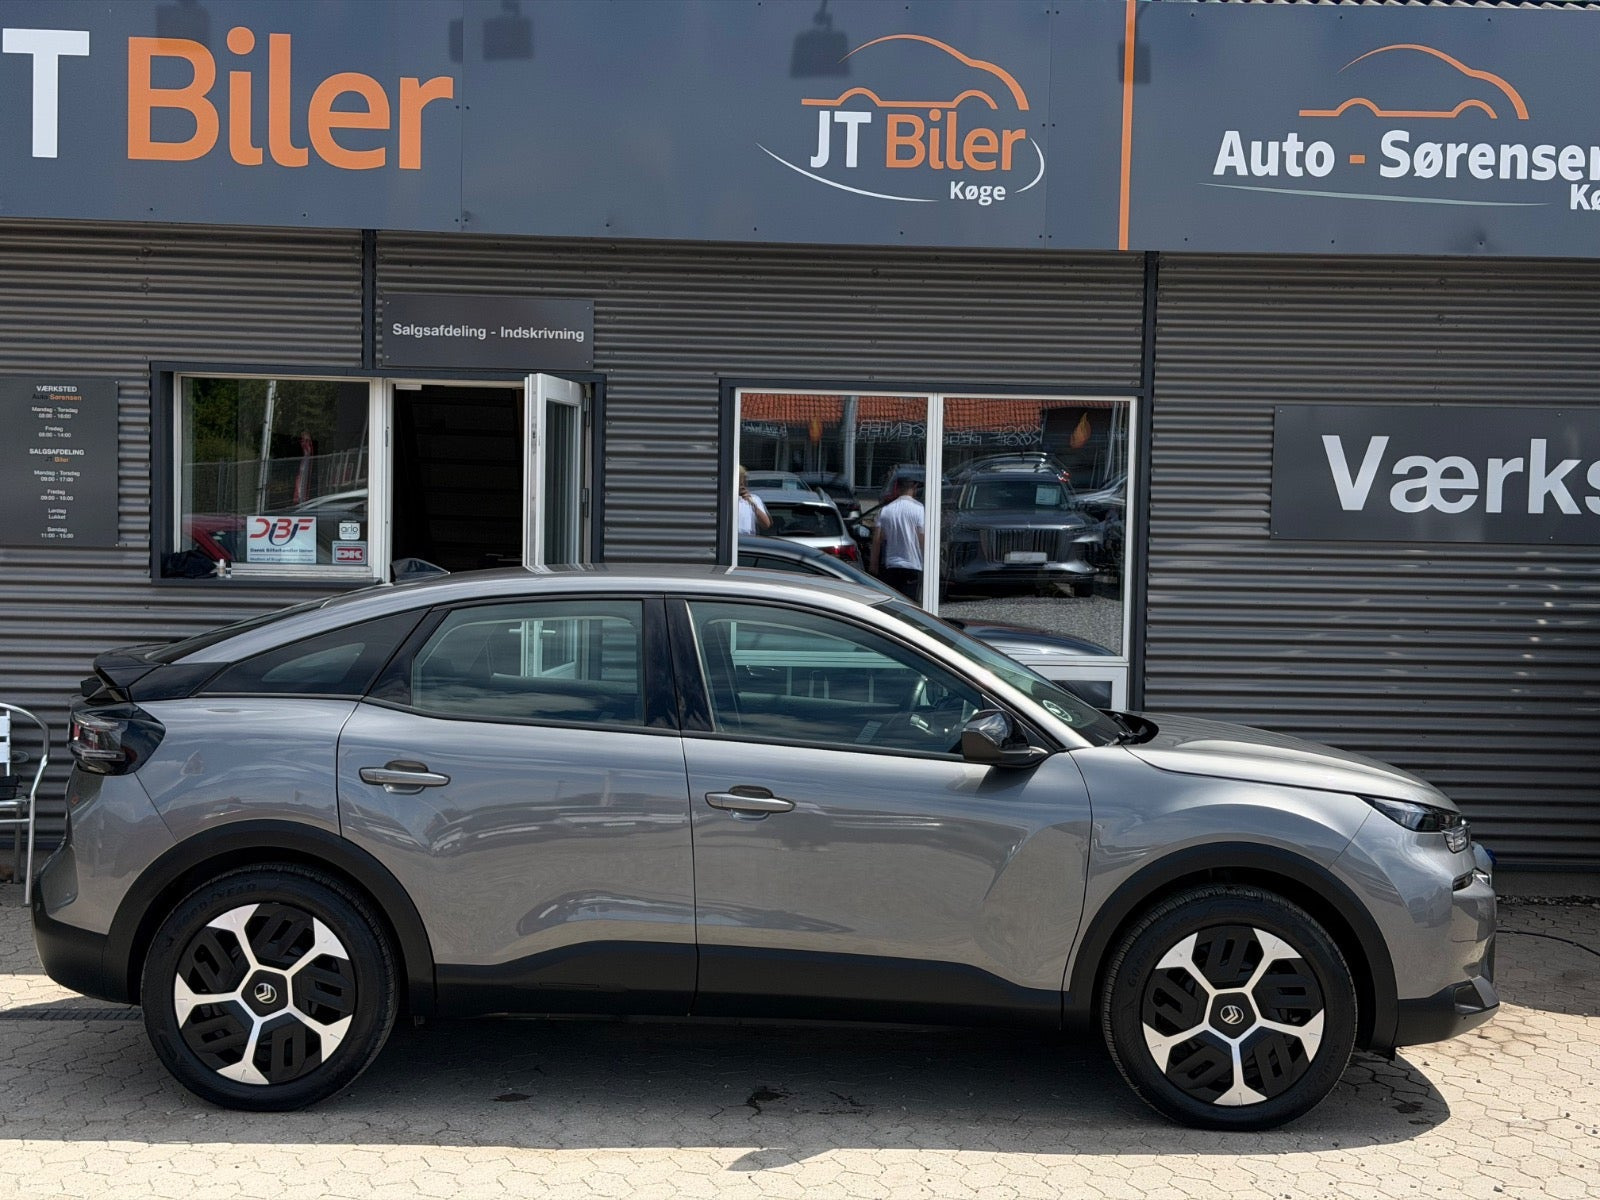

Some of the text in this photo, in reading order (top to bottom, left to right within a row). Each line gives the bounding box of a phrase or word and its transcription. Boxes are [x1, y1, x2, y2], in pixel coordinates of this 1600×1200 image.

[2, 26, 454, 170] T Biler
[810, 108, 1027, 171] JT Biler
[1212, 129, 1336, 178] Auto
[1348, 153, 1366, 165] -
[949, 180, 1007, 206] Køge
[392, 322, 487, 341] Salgsafdeling
[500, 325, 585, 342] Indskrivning
[36, 385, 78, 393] VÆRKSTED
[29, 448, 85, 456] SALGSAFDELING
[340, 525, 359, 533] arlo
